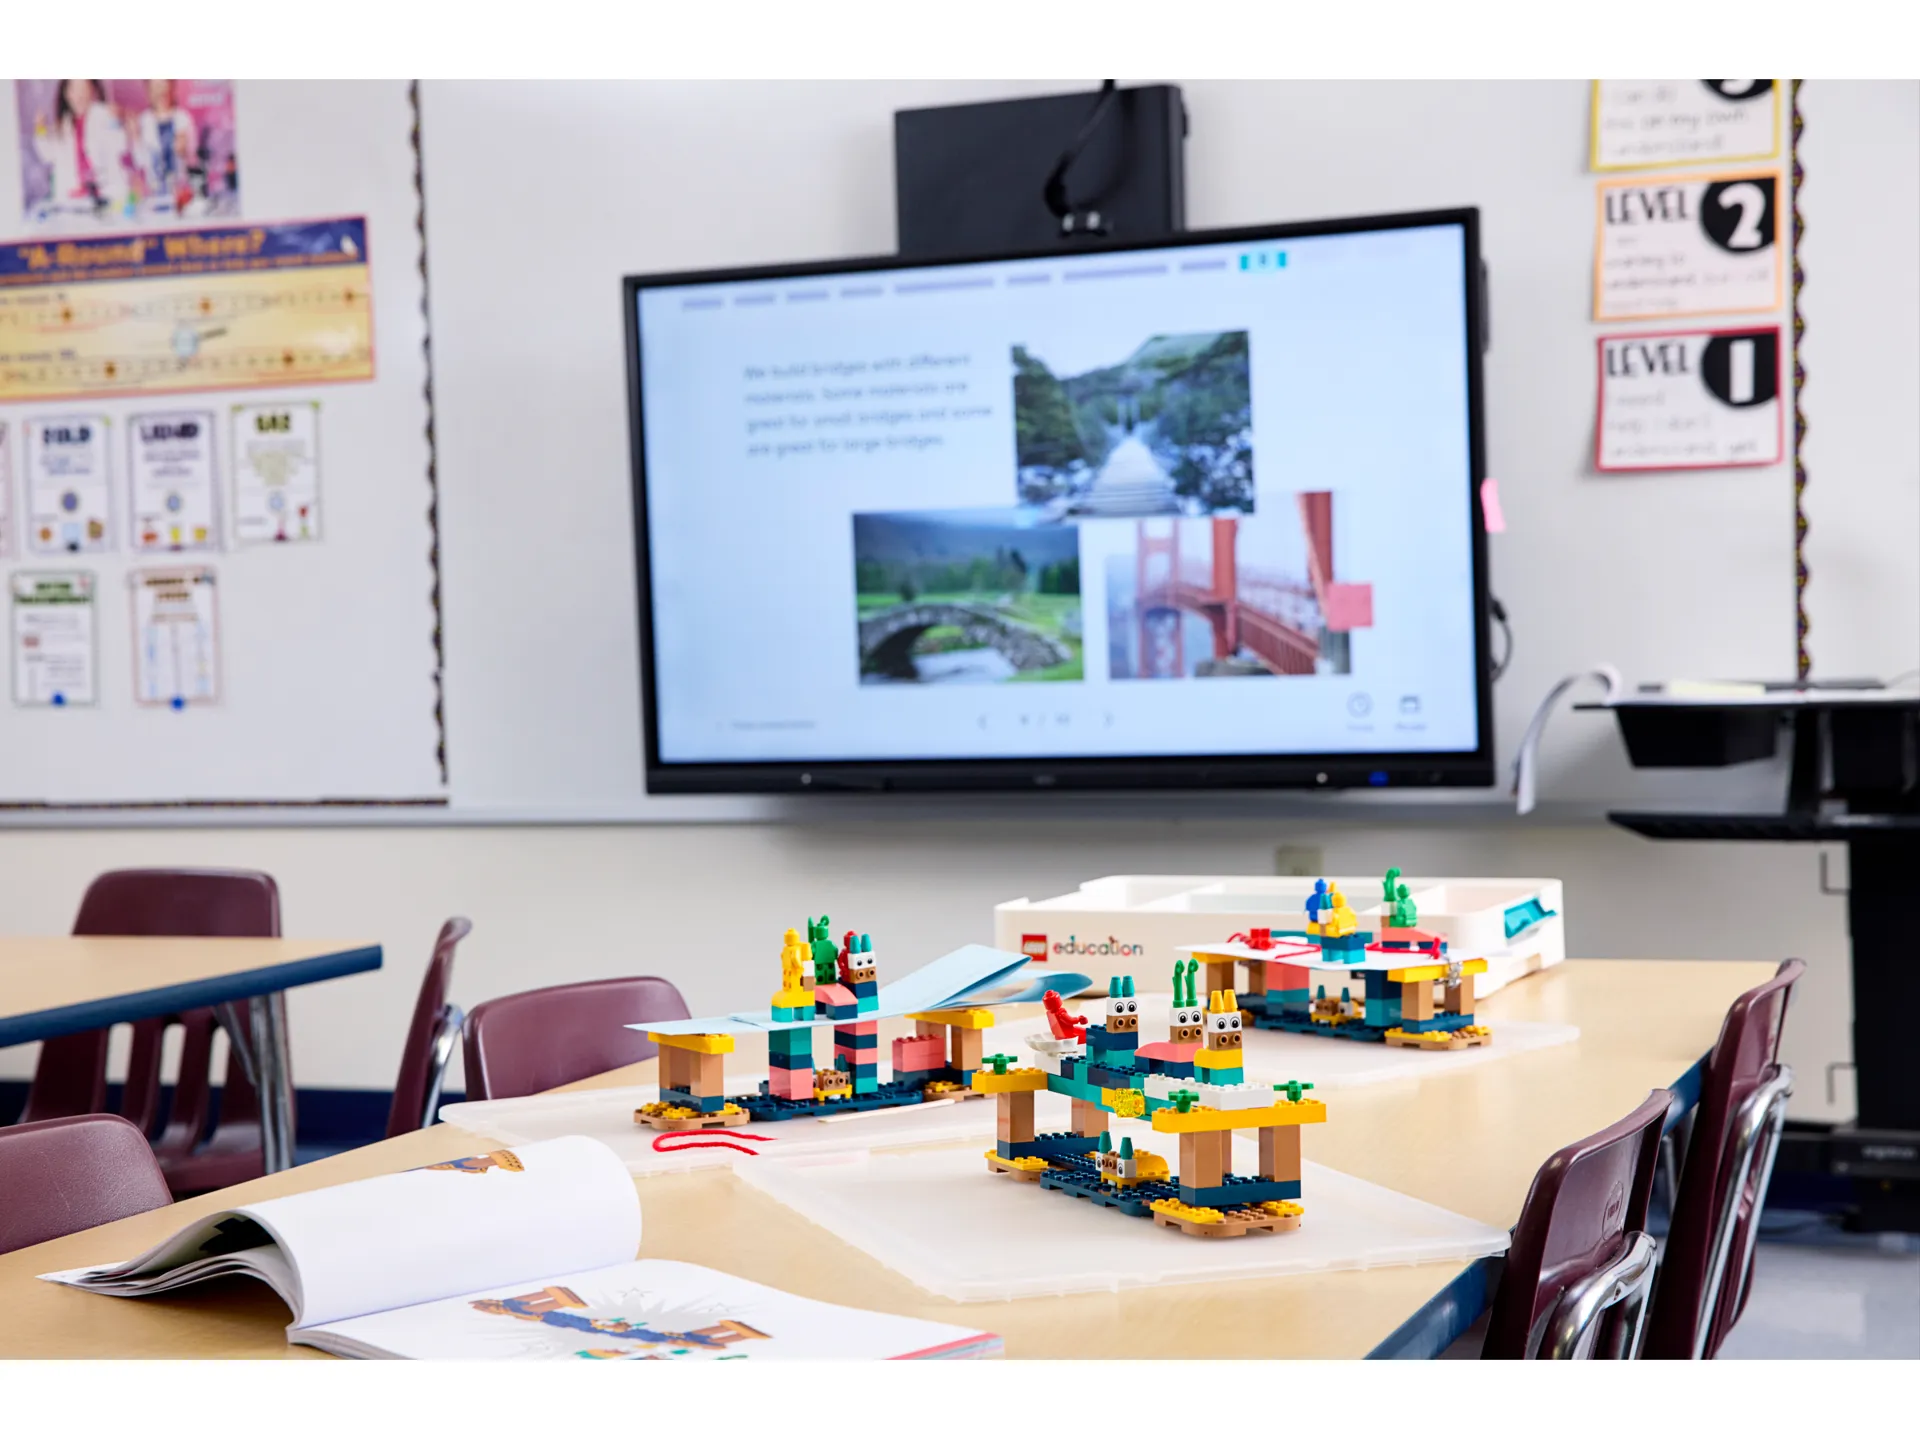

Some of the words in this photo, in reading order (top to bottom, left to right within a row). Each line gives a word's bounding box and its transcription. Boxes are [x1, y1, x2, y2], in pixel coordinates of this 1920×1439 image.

[1605, 187, 1687, 225] LEVEL
[1718, 182, 1766, 248] 2
[1607, 342, 1688, 378] LEVEL
[1729, 338, 1755, 404] 1
[1053, 935, 1144, 957] education
